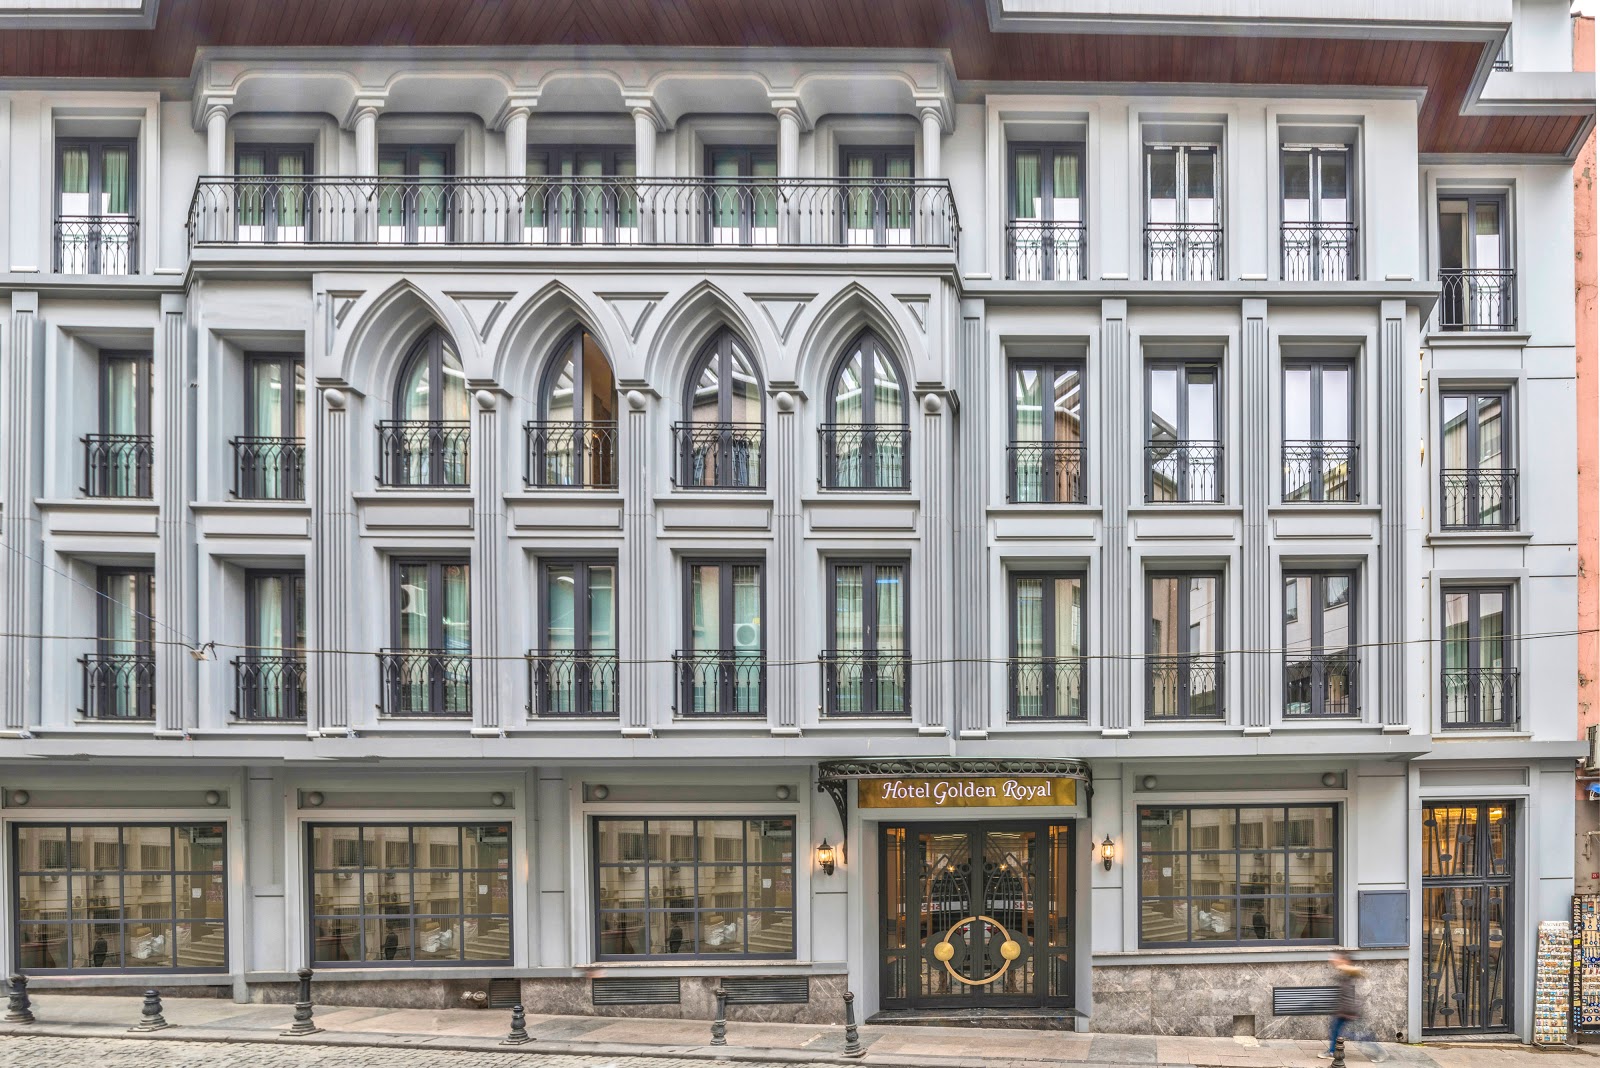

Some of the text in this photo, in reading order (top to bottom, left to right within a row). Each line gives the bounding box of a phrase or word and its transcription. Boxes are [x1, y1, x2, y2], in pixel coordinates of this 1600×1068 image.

[882, 779, 1052, 805] Hotel Golden Royal
